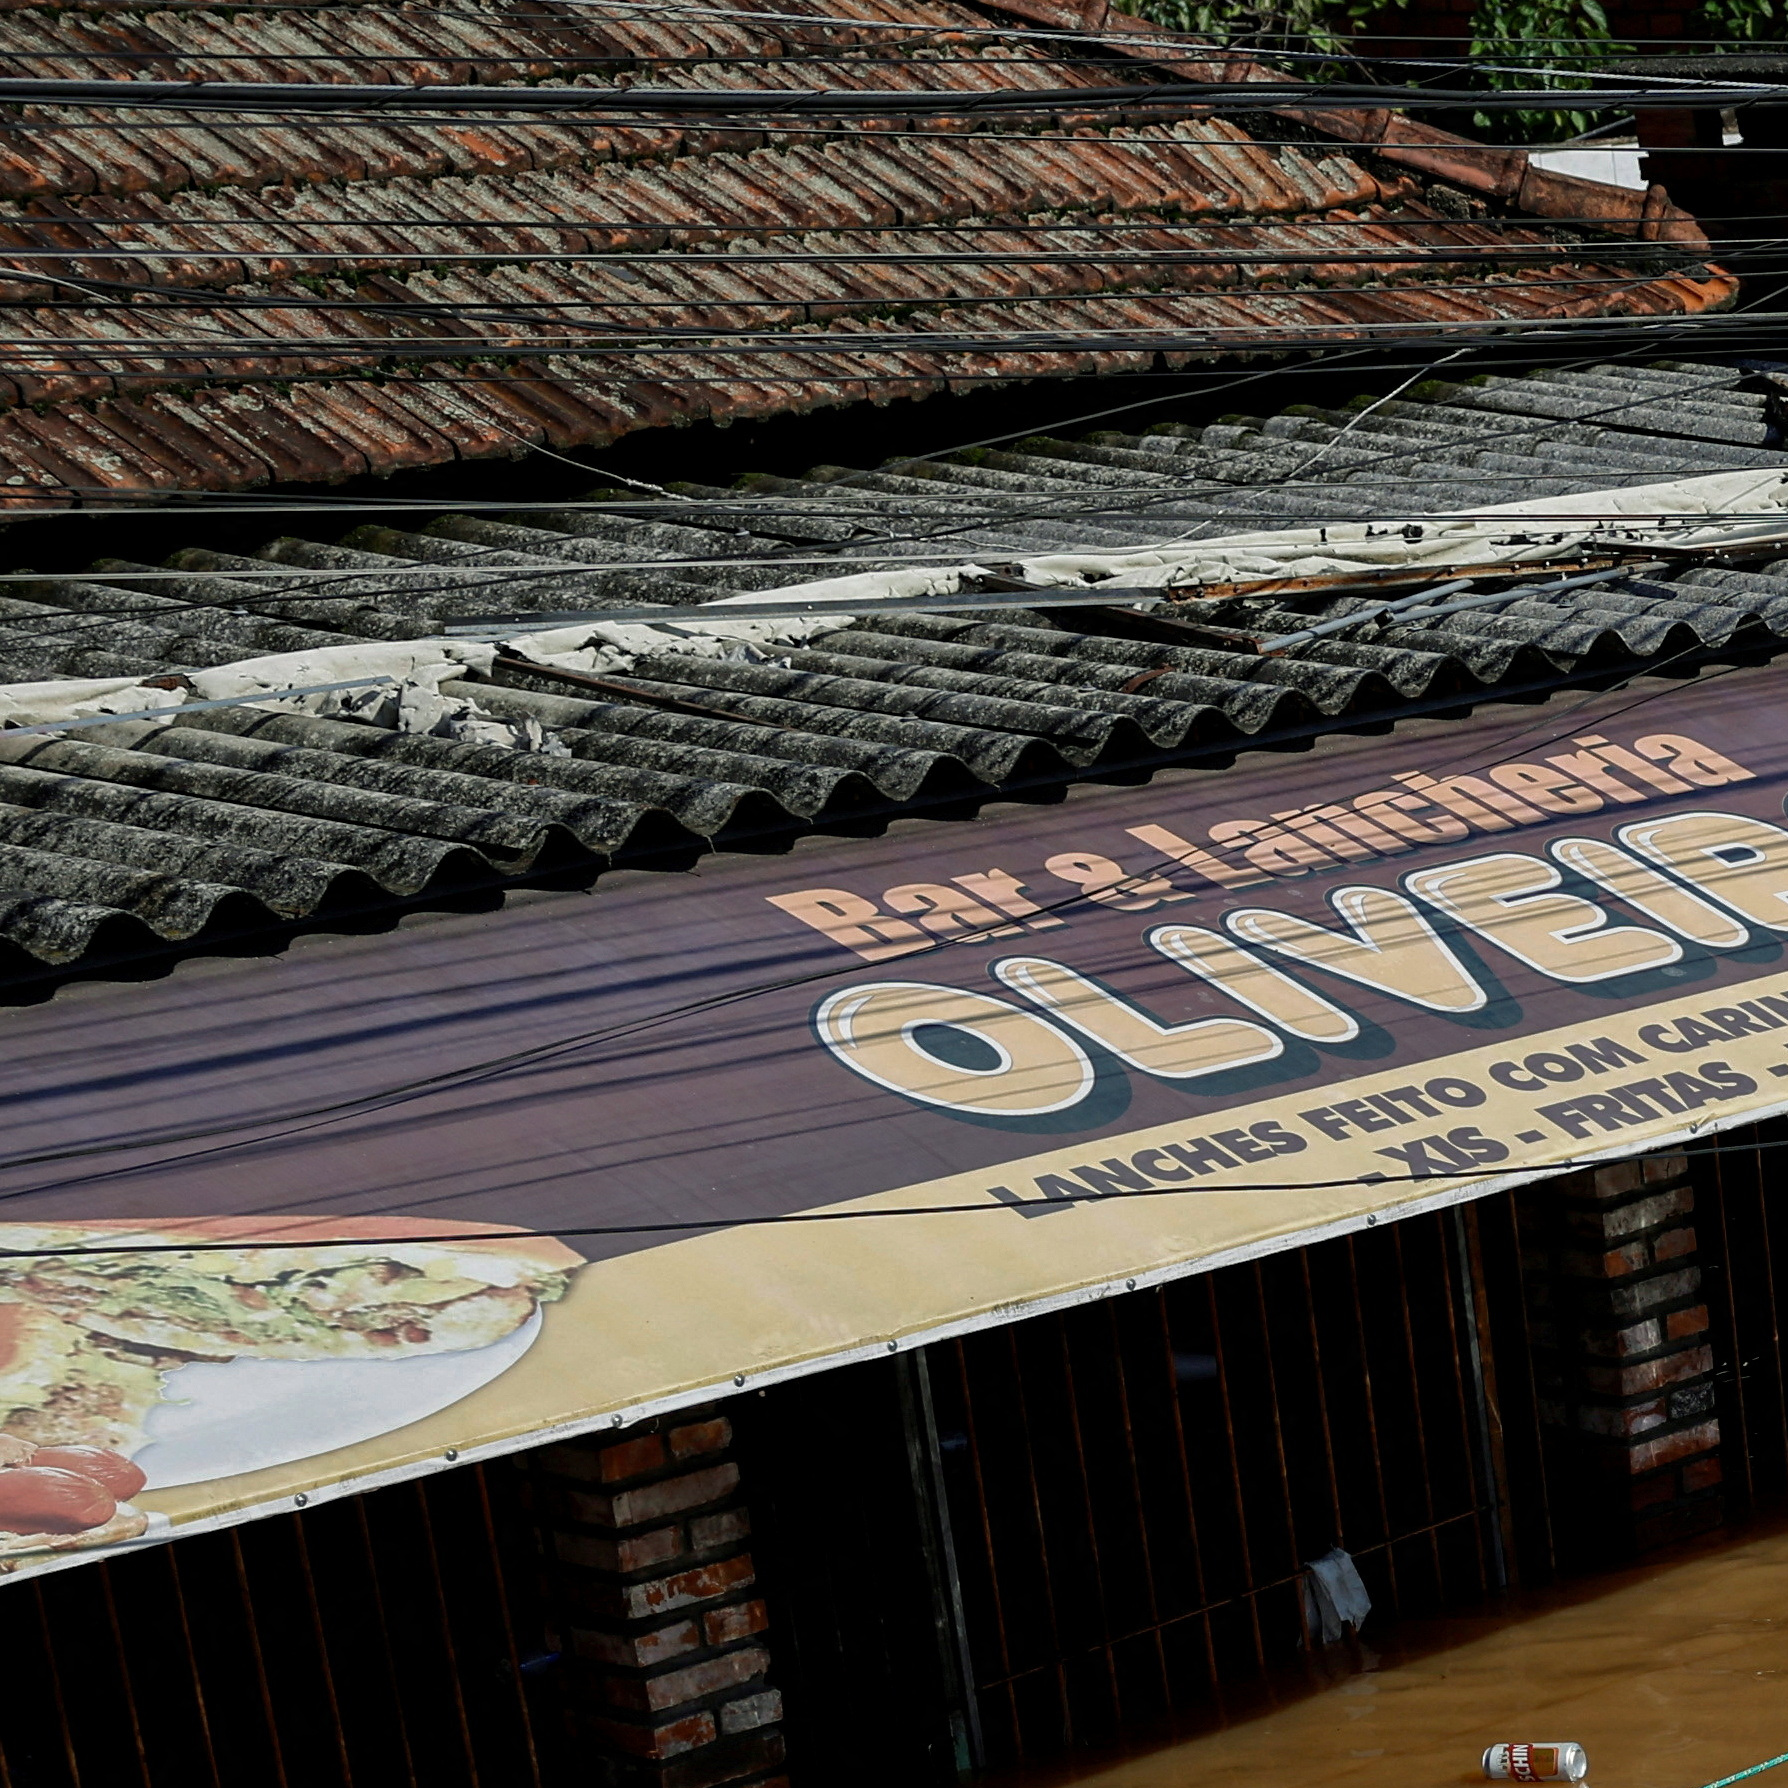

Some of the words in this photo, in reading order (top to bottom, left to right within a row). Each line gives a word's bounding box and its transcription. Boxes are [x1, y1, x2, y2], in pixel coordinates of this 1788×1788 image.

[765, 868, 1066, 962] Bar
[1045, 852, 1196, 911] &
[1125, 733, 1757, 890] Lancheria
[986, 1120, 1308, 1220] LANCHES
[1297, 1077, 1488, 1142] FEITO
[1488, 1034, 1647, 1092] COM
[1373, 1126, 1511, 1185] XIS
[1534, 1060, 1759, 1140] FRITAS
